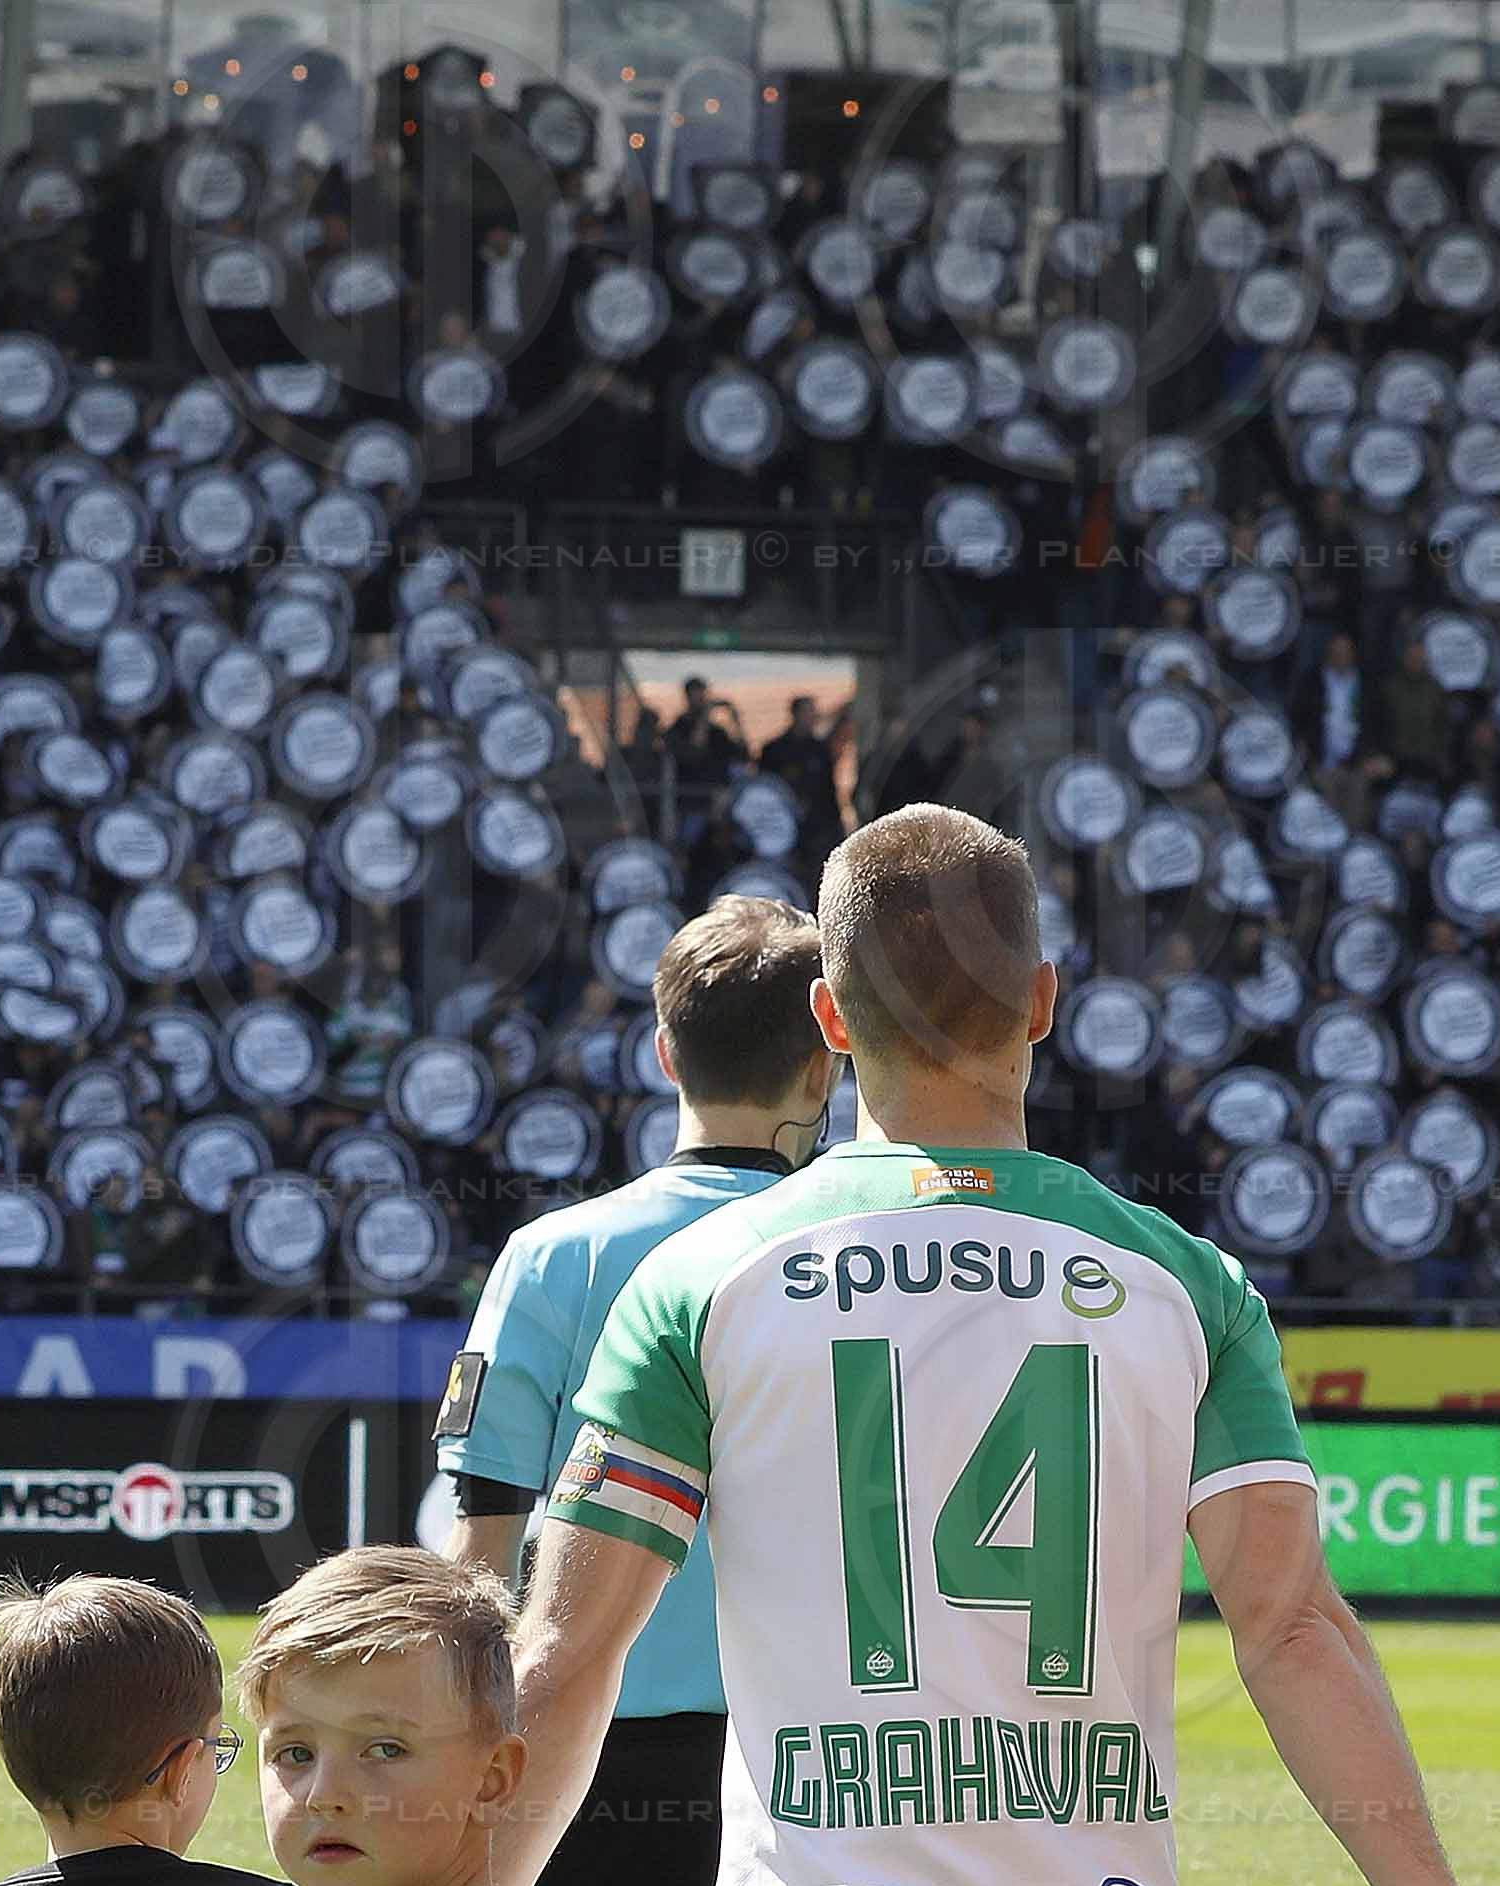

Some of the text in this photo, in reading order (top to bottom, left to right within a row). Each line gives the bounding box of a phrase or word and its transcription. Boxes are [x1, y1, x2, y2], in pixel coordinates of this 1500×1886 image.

[783, 1241, 1045, 1312] spusu
[830, 1337, 1101, 1697] 14
[1319, 1474, 1499, 1547] RGIE
